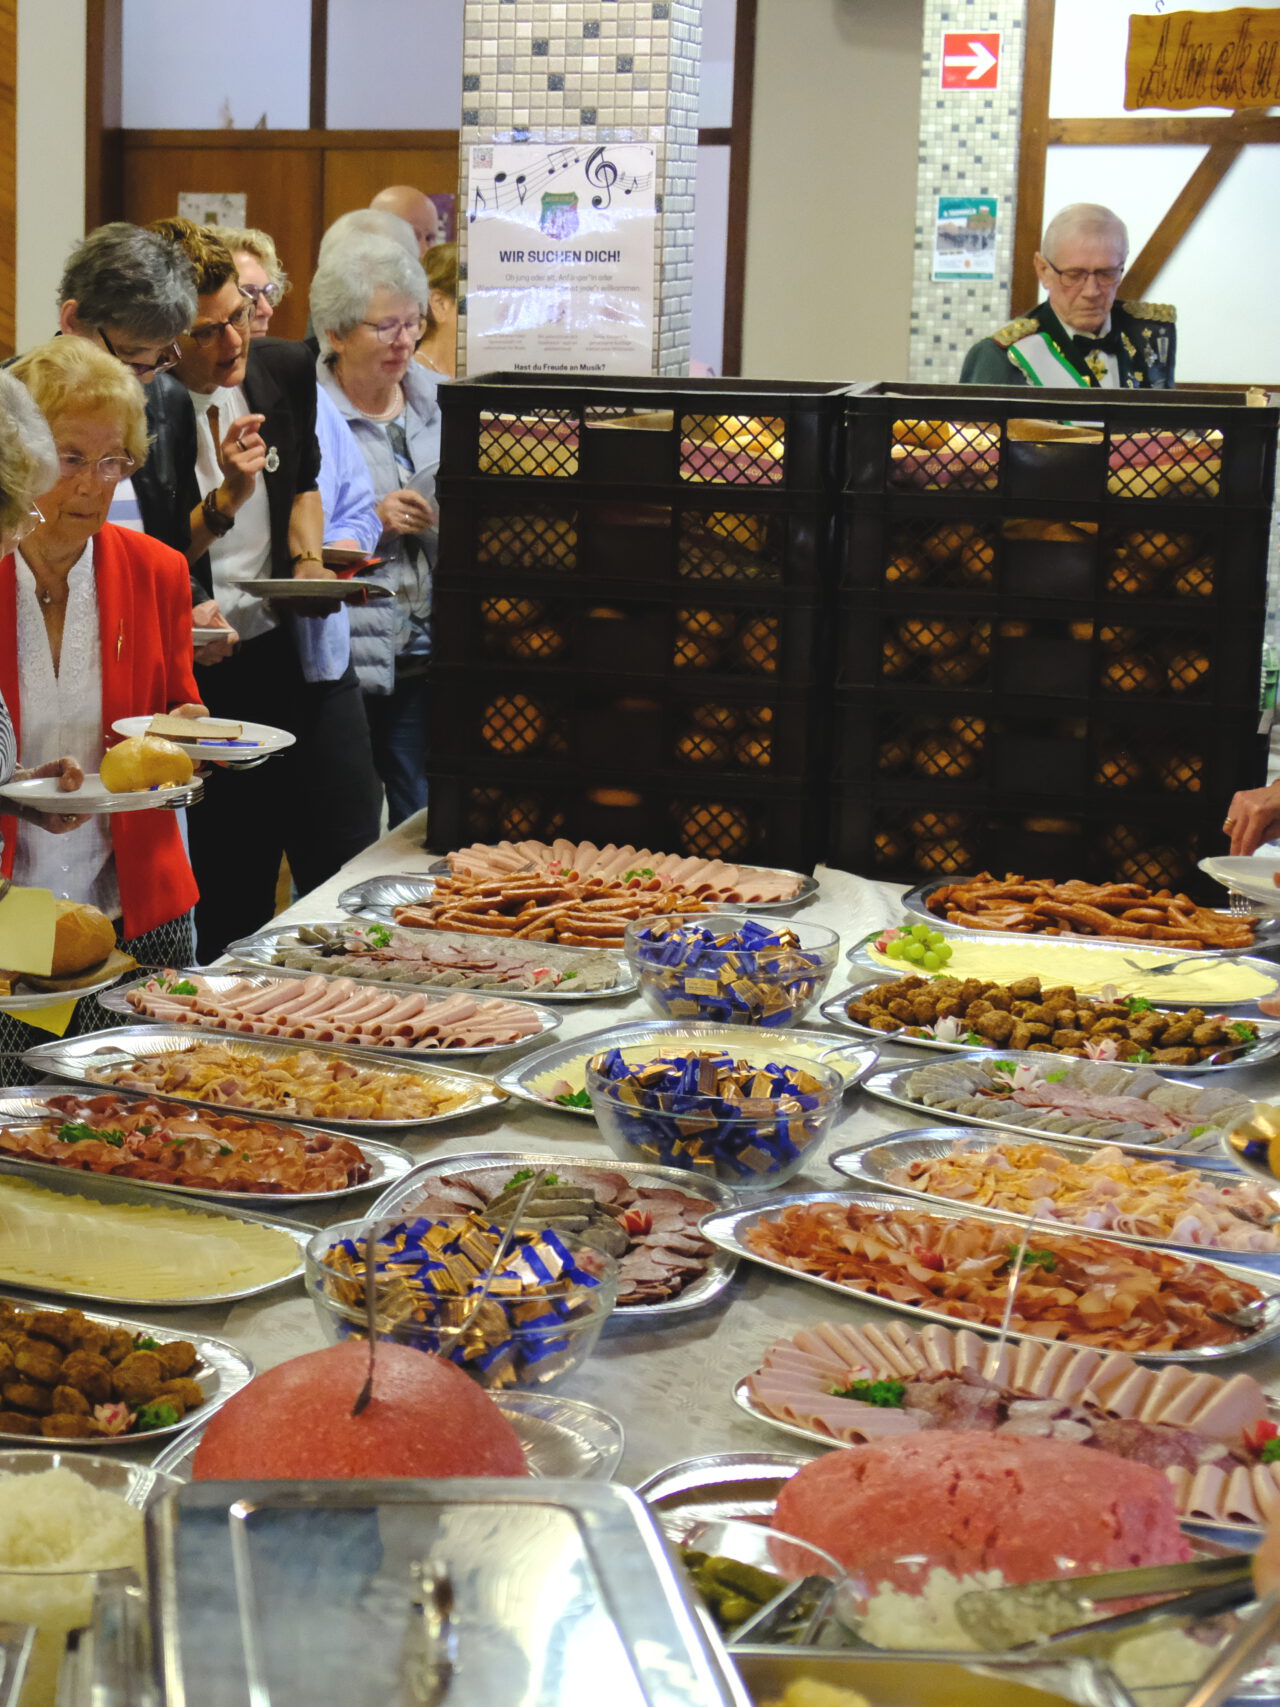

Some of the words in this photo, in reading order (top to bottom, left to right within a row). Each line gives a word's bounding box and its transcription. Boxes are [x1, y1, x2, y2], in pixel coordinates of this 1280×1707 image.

[1136, 16, 1280, 108] Almeku
[499, 250, 525, 263] WIR
[527, 250, 582, 263] SUCHEN
[585, 250, 621, 263] DICH!
